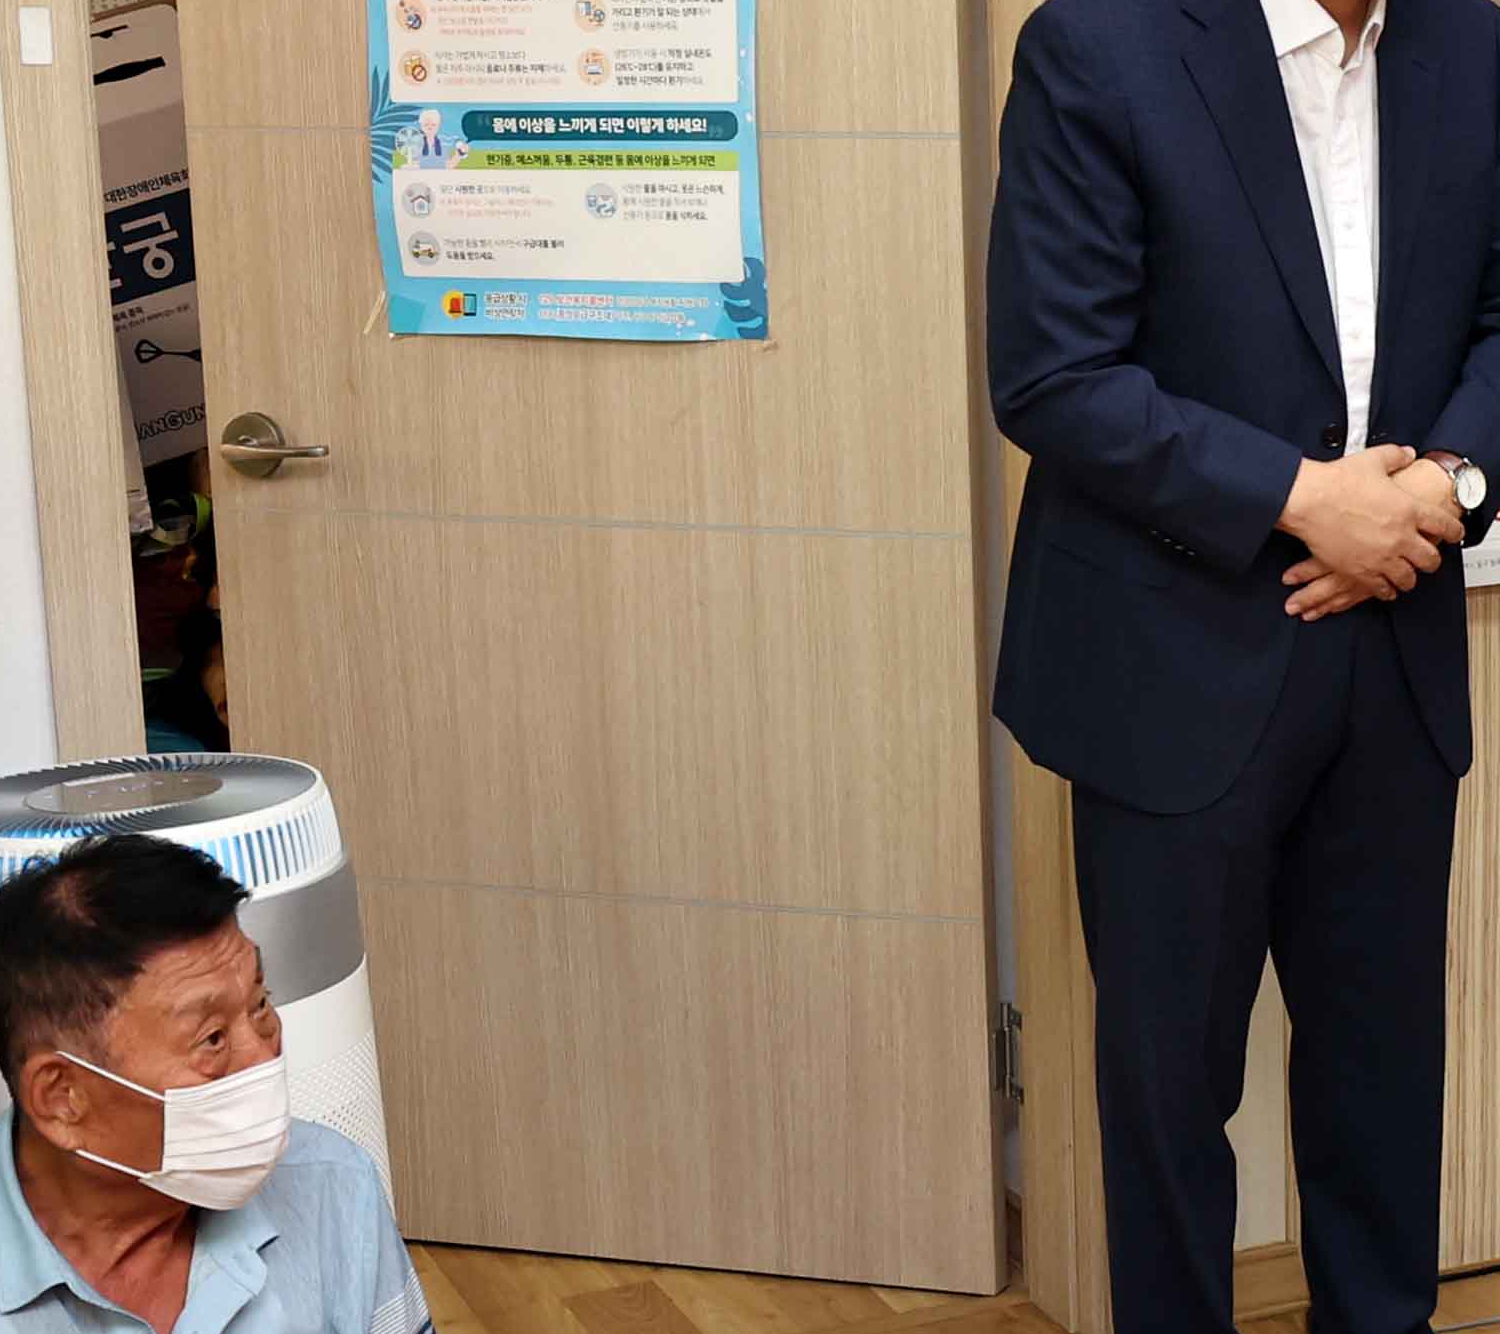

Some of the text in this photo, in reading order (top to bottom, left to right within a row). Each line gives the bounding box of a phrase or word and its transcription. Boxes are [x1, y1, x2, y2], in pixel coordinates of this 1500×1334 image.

[492, 117, 708, 134] 몸에 이상을 느끼게 되면 이렇게 하세요!
[615, 154, 624, 165] 등
[626, 154, 644, 166] 몸에
[645, 154, 670, 166] 이상을
[672, 154, 697, 166] 느끼게
[699, 154, 716, 165] 되면
